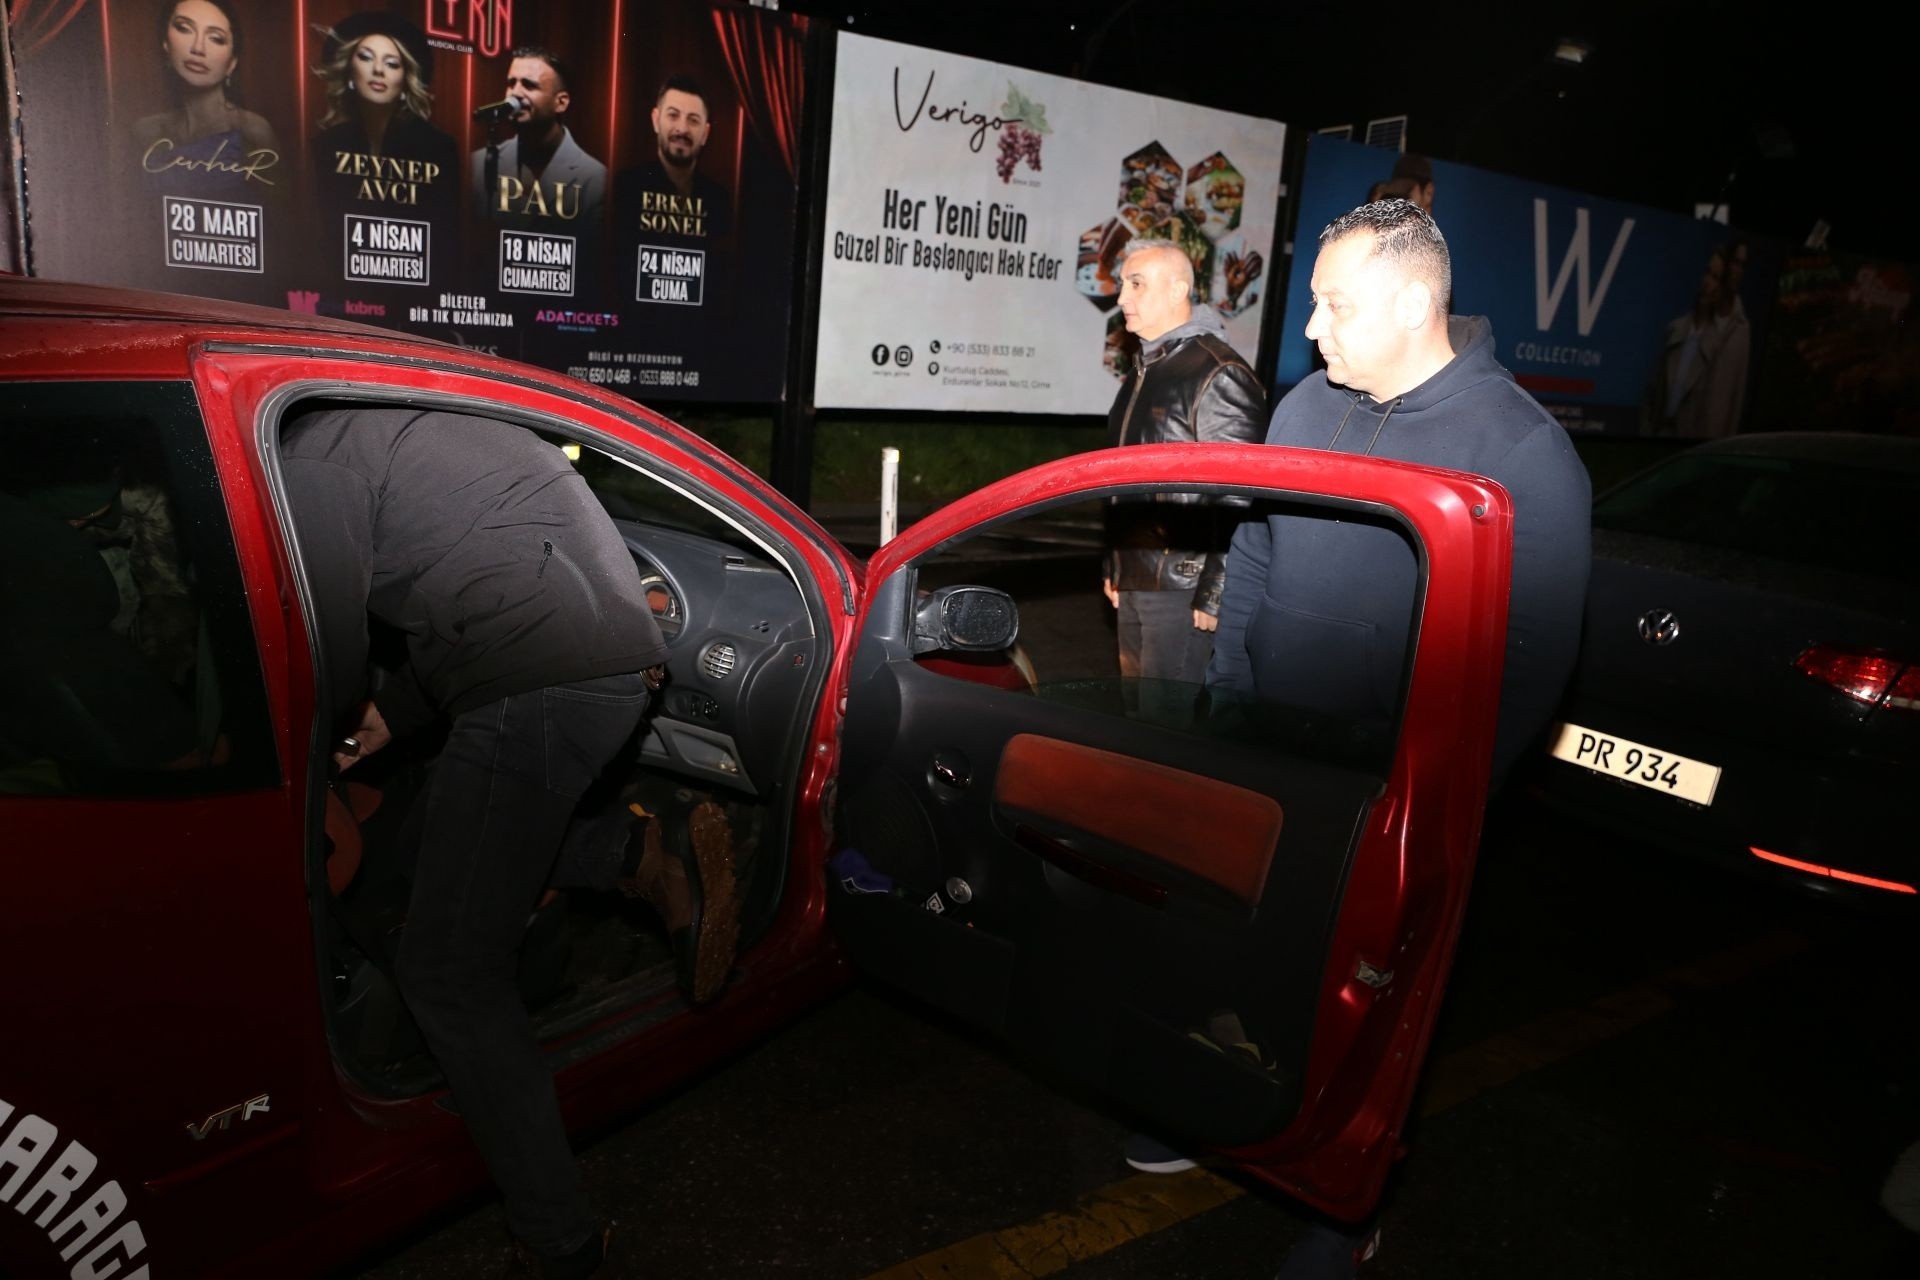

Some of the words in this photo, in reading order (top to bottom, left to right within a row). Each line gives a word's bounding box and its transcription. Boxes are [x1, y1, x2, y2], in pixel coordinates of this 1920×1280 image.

[456, 43, 474, 54] CLUB
[893, 66, 1025, 153] Verigo
[334, 150, 440, 184] ZEYNEP
[357, 178, 418, 206] AVCI
[497, 174, 582, 220] PAU
[641, 190, 708, 218] ERKAL
[170, 203, 196, 232] 28
[203, 206, 259, 239] MART
[639, 213, 708, 238] SONEL
[882, 188, 927, 232] Her
[935, 195, 982, 239] Yeni
[987, 202, 1028, 244] Gün
[351, 221, 365, 248] 4
[369, 219, 423, 253] NİSAN
[171, 238, 257, 268] CUMARTESİ
[503, 237, 523, 262] 18
[527, 236, 572, 266] NİSAN
[641, 251, 659, 274] 24
[661, 250, 702, 278] NİSAN
[834, 231, 880, 263] Güzel
[884, 236, 909, 266] Bir
[913, 239, 994, 281] Başlangıcı
[997, 248, 1024, 278] Hak
[1028, 251, 1063, 281] Eder
[349, 252, 424, 280] CUMARTESİ
[503, 266, 572, 293] CUMARTESİ
[1533, 197, 1637, 337] W
[439, 292, 486, 311] BİLETLER
[651, 278, 689, 302] CUMA
[409, 306, 429, 323] BİR
[432, 309, 449, 324] TIK
[452, 308, 514, 328] UZAĞINIZDA
[535, 309, 619, 327] ADATICKETS
[613, 353, 625, 363] ve
[1514, 341, 1602, 367] COLLECTION
[1576, 732, 1616, 769] PR
[1624, 748, 1681, 789] 934
[184, 1092, 271, 1141] VTR
